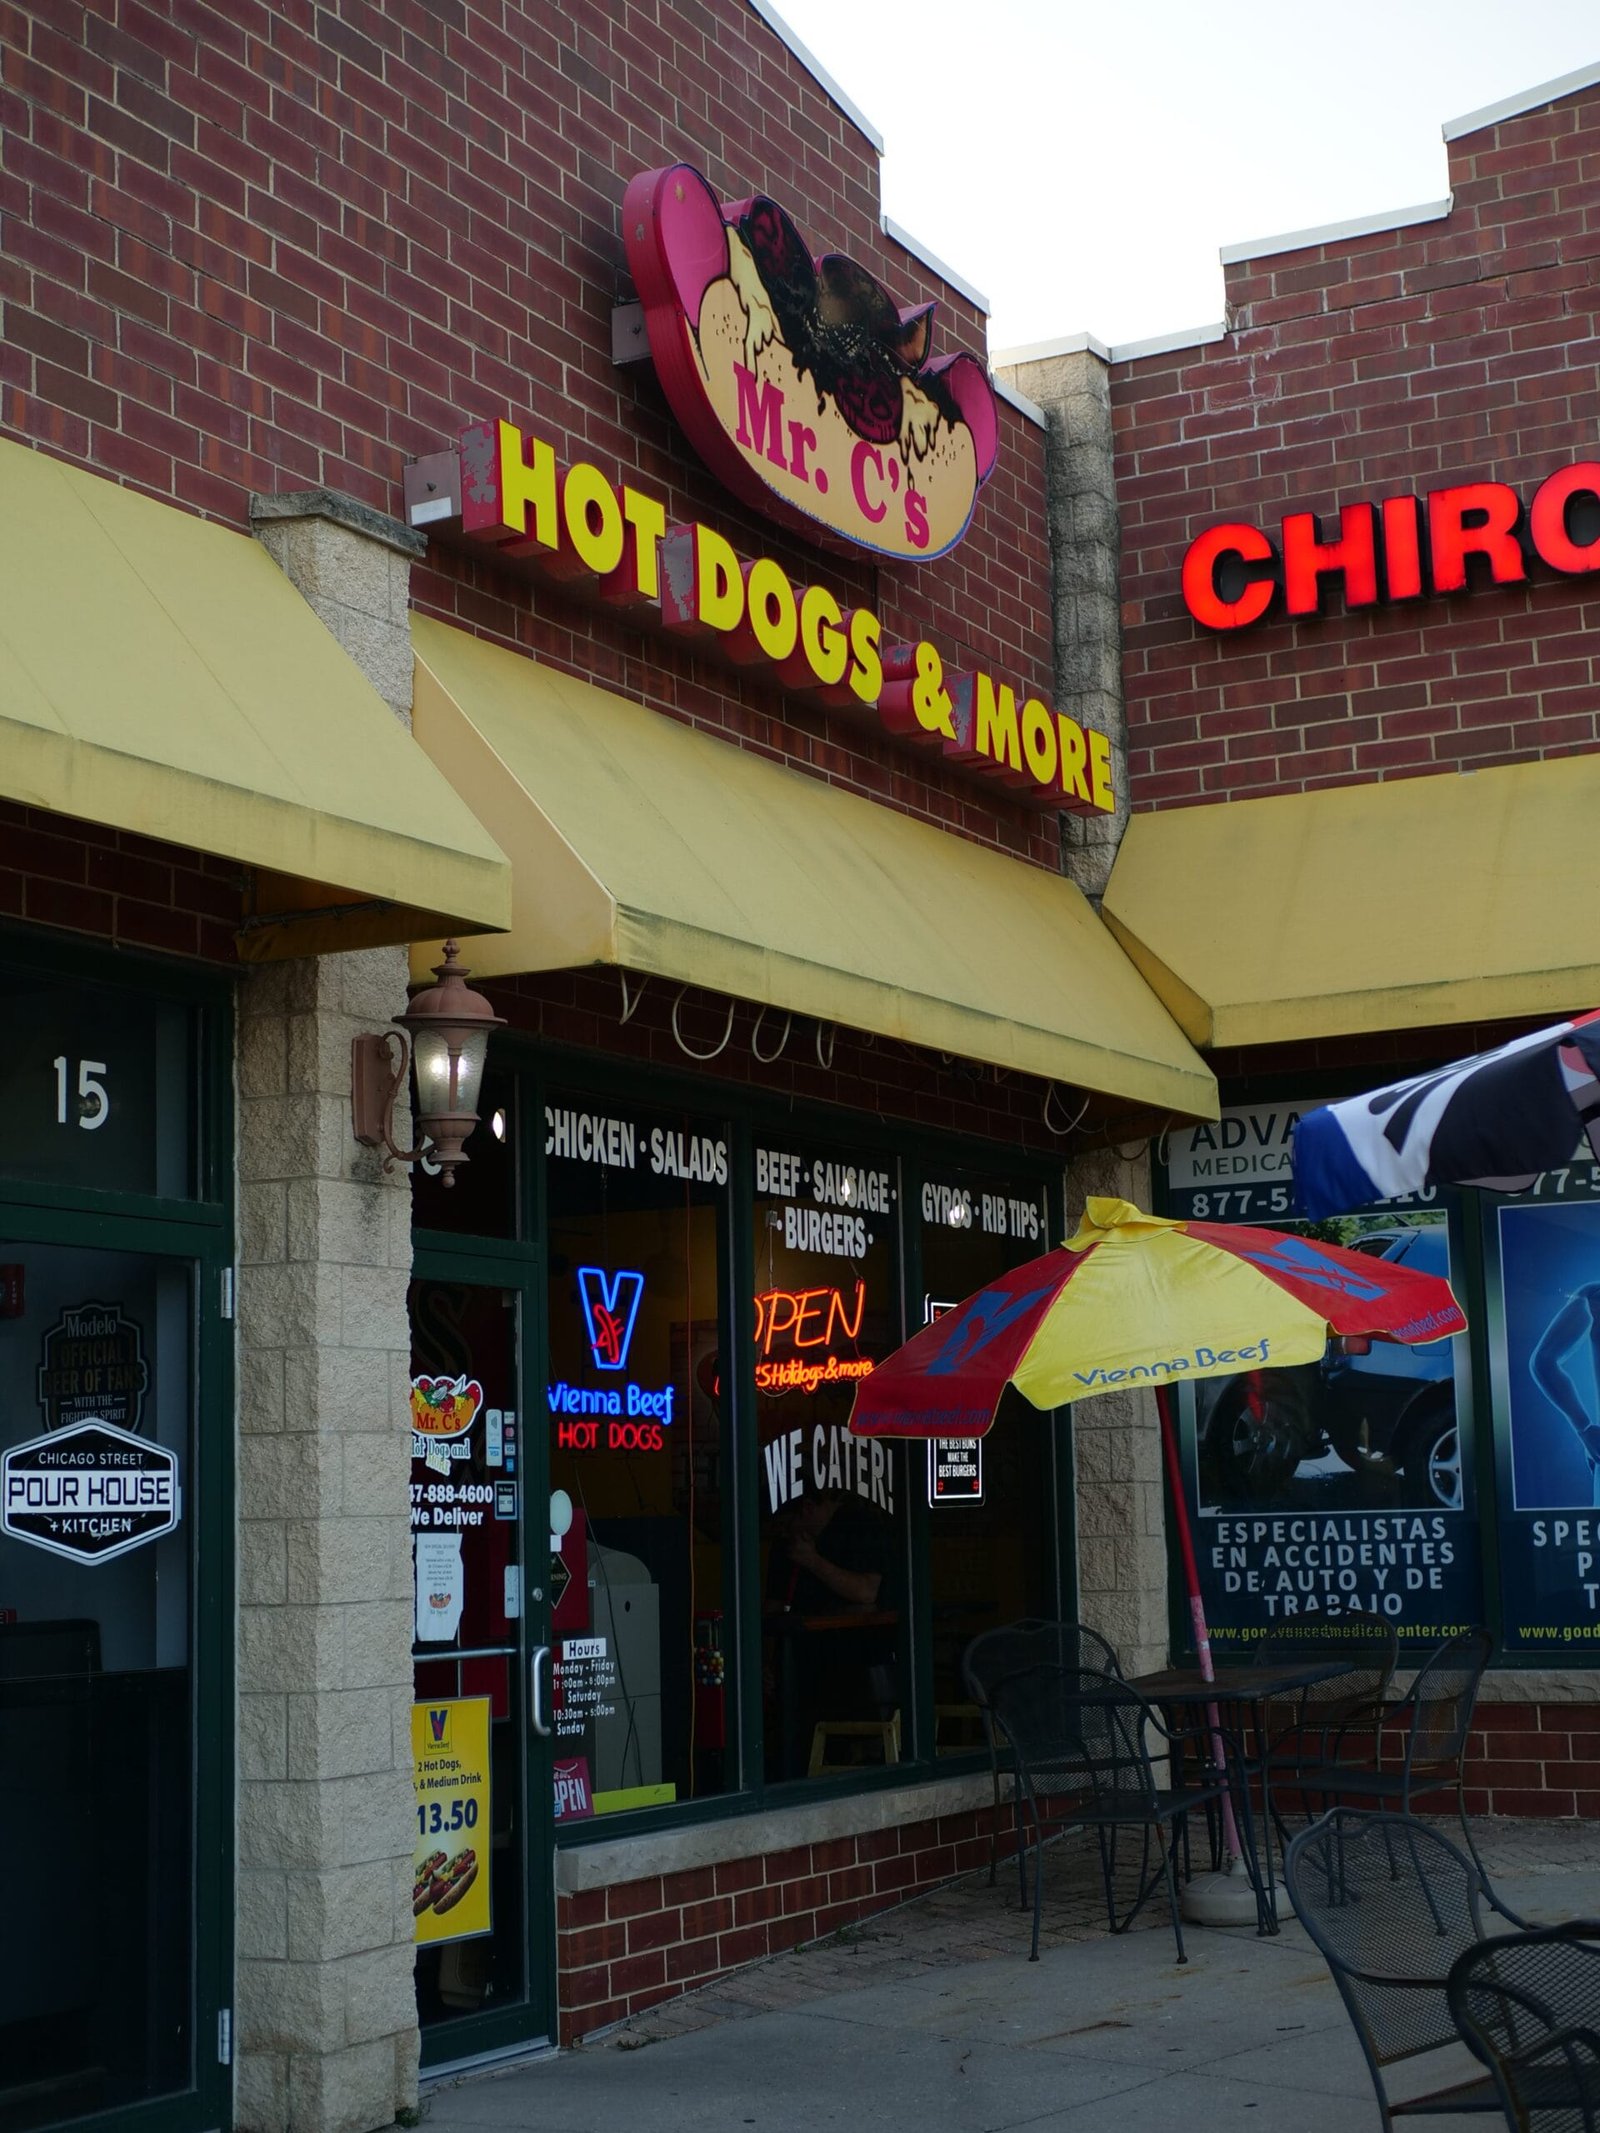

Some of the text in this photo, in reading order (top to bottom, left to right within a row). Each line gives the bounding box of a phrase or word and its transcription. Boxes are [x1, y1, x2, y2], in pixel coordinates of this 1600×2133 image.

[733, 361, 931, 549] Mr. C's
[1181, 461, 1600, 631] CHIRO
[500, 419, 1115, 815] HOT DOGS & MORE
[54, 1056, 109, 1130] 15
[651, 1127, 728, 1186] SALADS
[757, 1148, 890, 1214] BEEF SAUSAGE
[922, 1182, 1039, 1240] GYROS RIB TIPS
[785, 1206, 867, 1258] BURGERS
[67, 1313, 117, 1338] Modelo
[1072, 1338, 1270, 1386] Vienna Beef
[548, 1383, 674, 1425] Vienna Beef
[417, 1411, 461, 1431] Mr. C's
[452, 1440, 469, 1456] and
[558, 1422, 663, 1451] HOT DOGS
[38, 1451, 144, 1465] CHICAGO STREET
[764, 1424, 894, 1515] WE CATER!
[9, 1476, 170, 1506] POUR HOUSE
[433, 1507, 484, 1526] Deliver
[1217, 1517, 1446, 1544] ESPECIALISTAS
[1533, 1520, 1600, 1547] SPE
[1212, 1542, 1455, 1568] EN ACCIDENTES
[1224, 1567, 1443, 1592] DE AUTO Y DE
[1263, 1593, 1403, 1617] TRABAJO
[569, 1641, 600, 1657] Hours
[553, 1659, 615, 1676] Monday Friday
[567, 1689, 602, 1704] Saturday
[556, 1720, 586, 1736] Sunday
[424, 1760, 438, 1771] Hot
[440, 1759, 462, 1772] Dogs,
[419, 1779, 426, 1790] &
[427, 1777, 459, 1789] Medium
[460, 1772, 482, 1785] Drink
